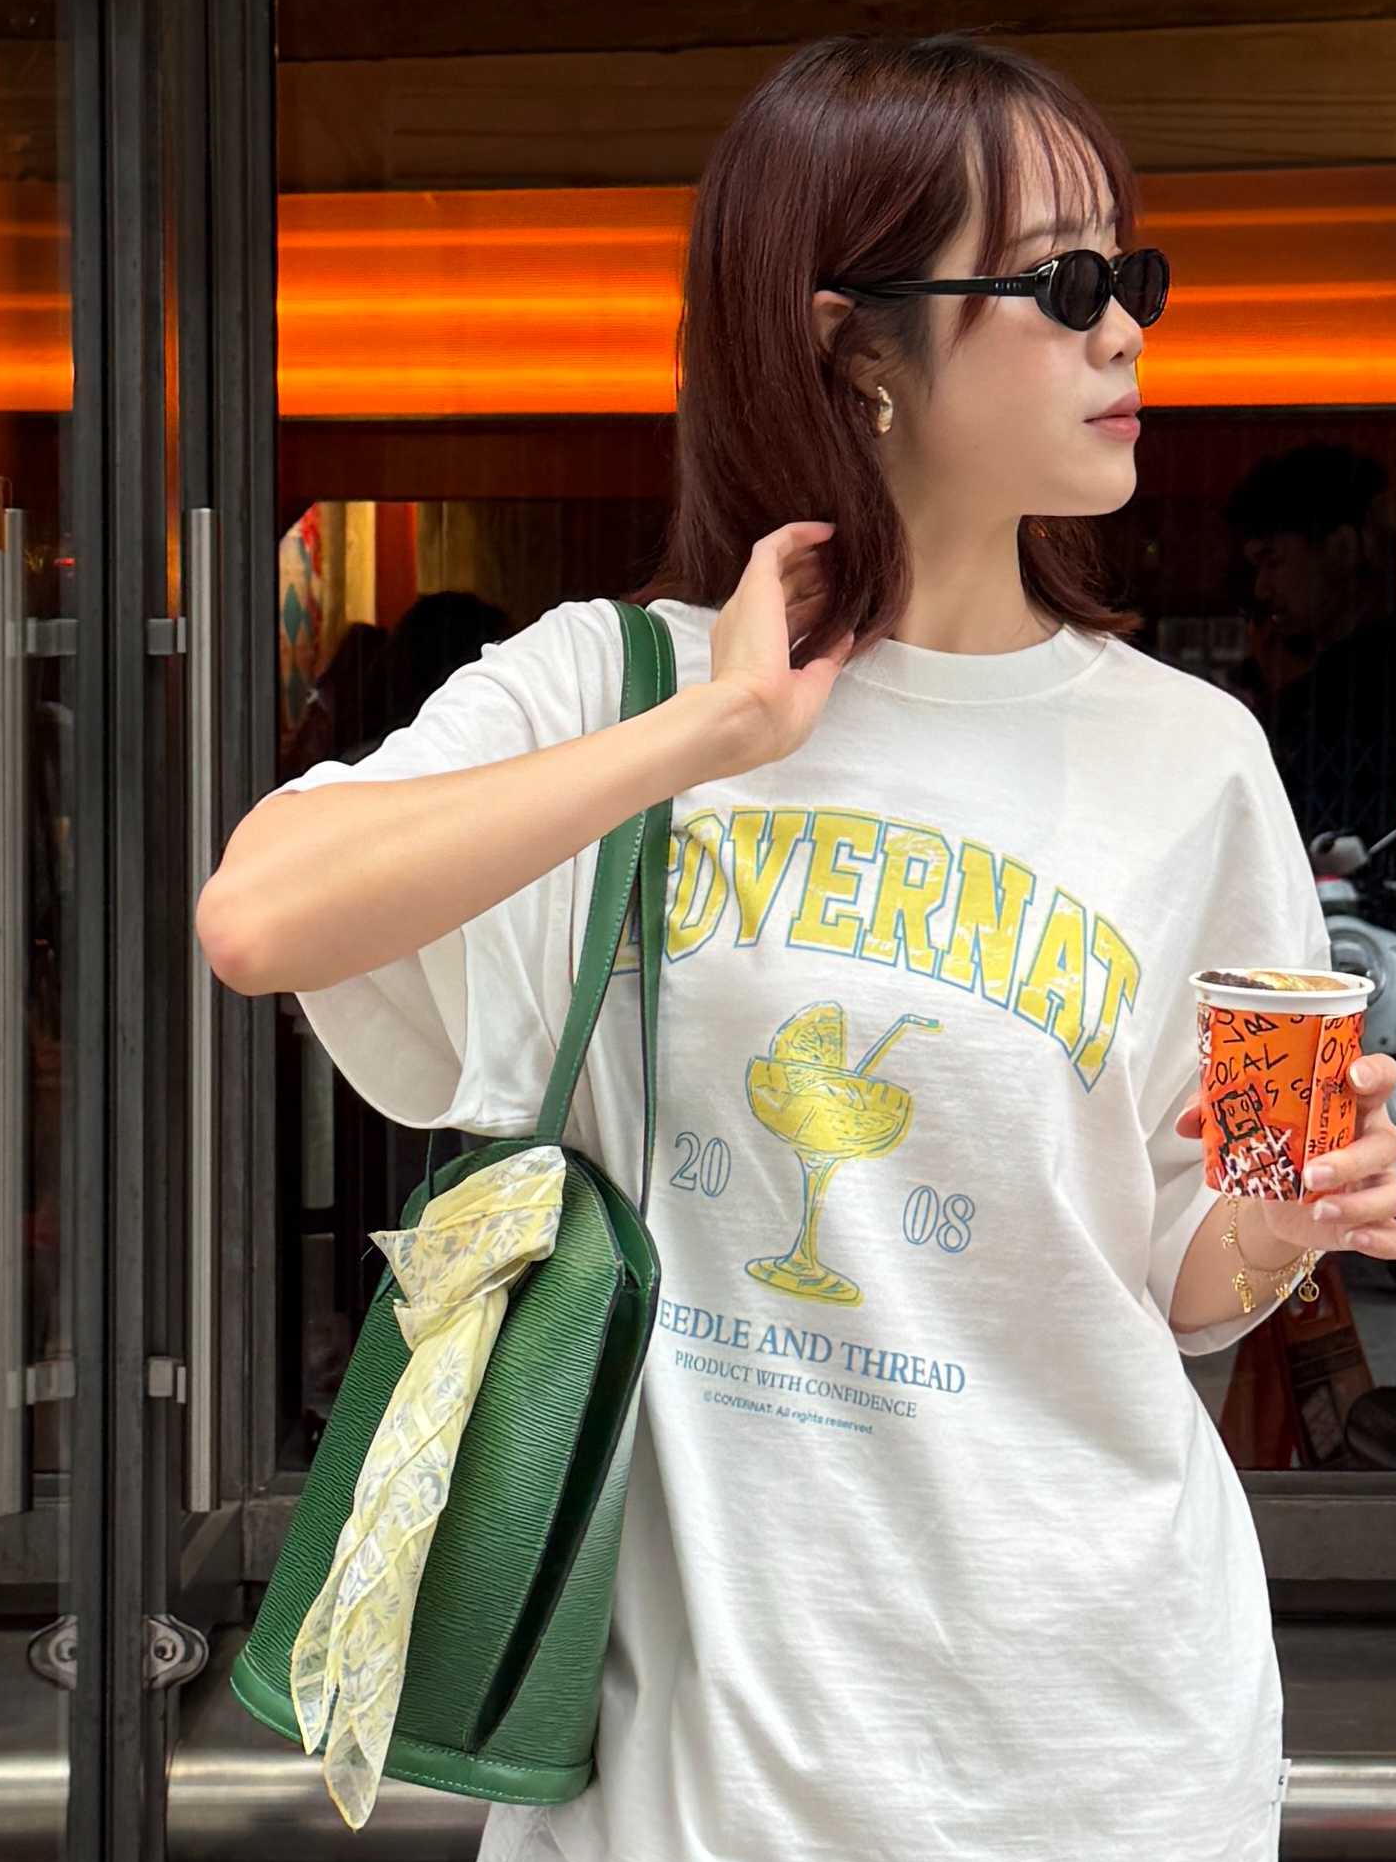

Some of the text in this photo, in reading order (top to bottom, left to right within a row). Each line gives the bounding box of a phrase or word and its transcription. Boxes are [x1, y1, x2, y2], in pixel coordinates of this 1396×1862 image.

[662, 808, 1141, 1092] OVERNAT
[672, 1132, 977, 1254] 20 08
[674, 1349, 918, 1419] PRODUCT WITH CONFIDENCE
[756, 1325, 833, 1364] AND
[840, 1341, 967, 1395] THREAD
[775, 1405, 791, 1418] All
[791, 1410, 824, 1425] rights
